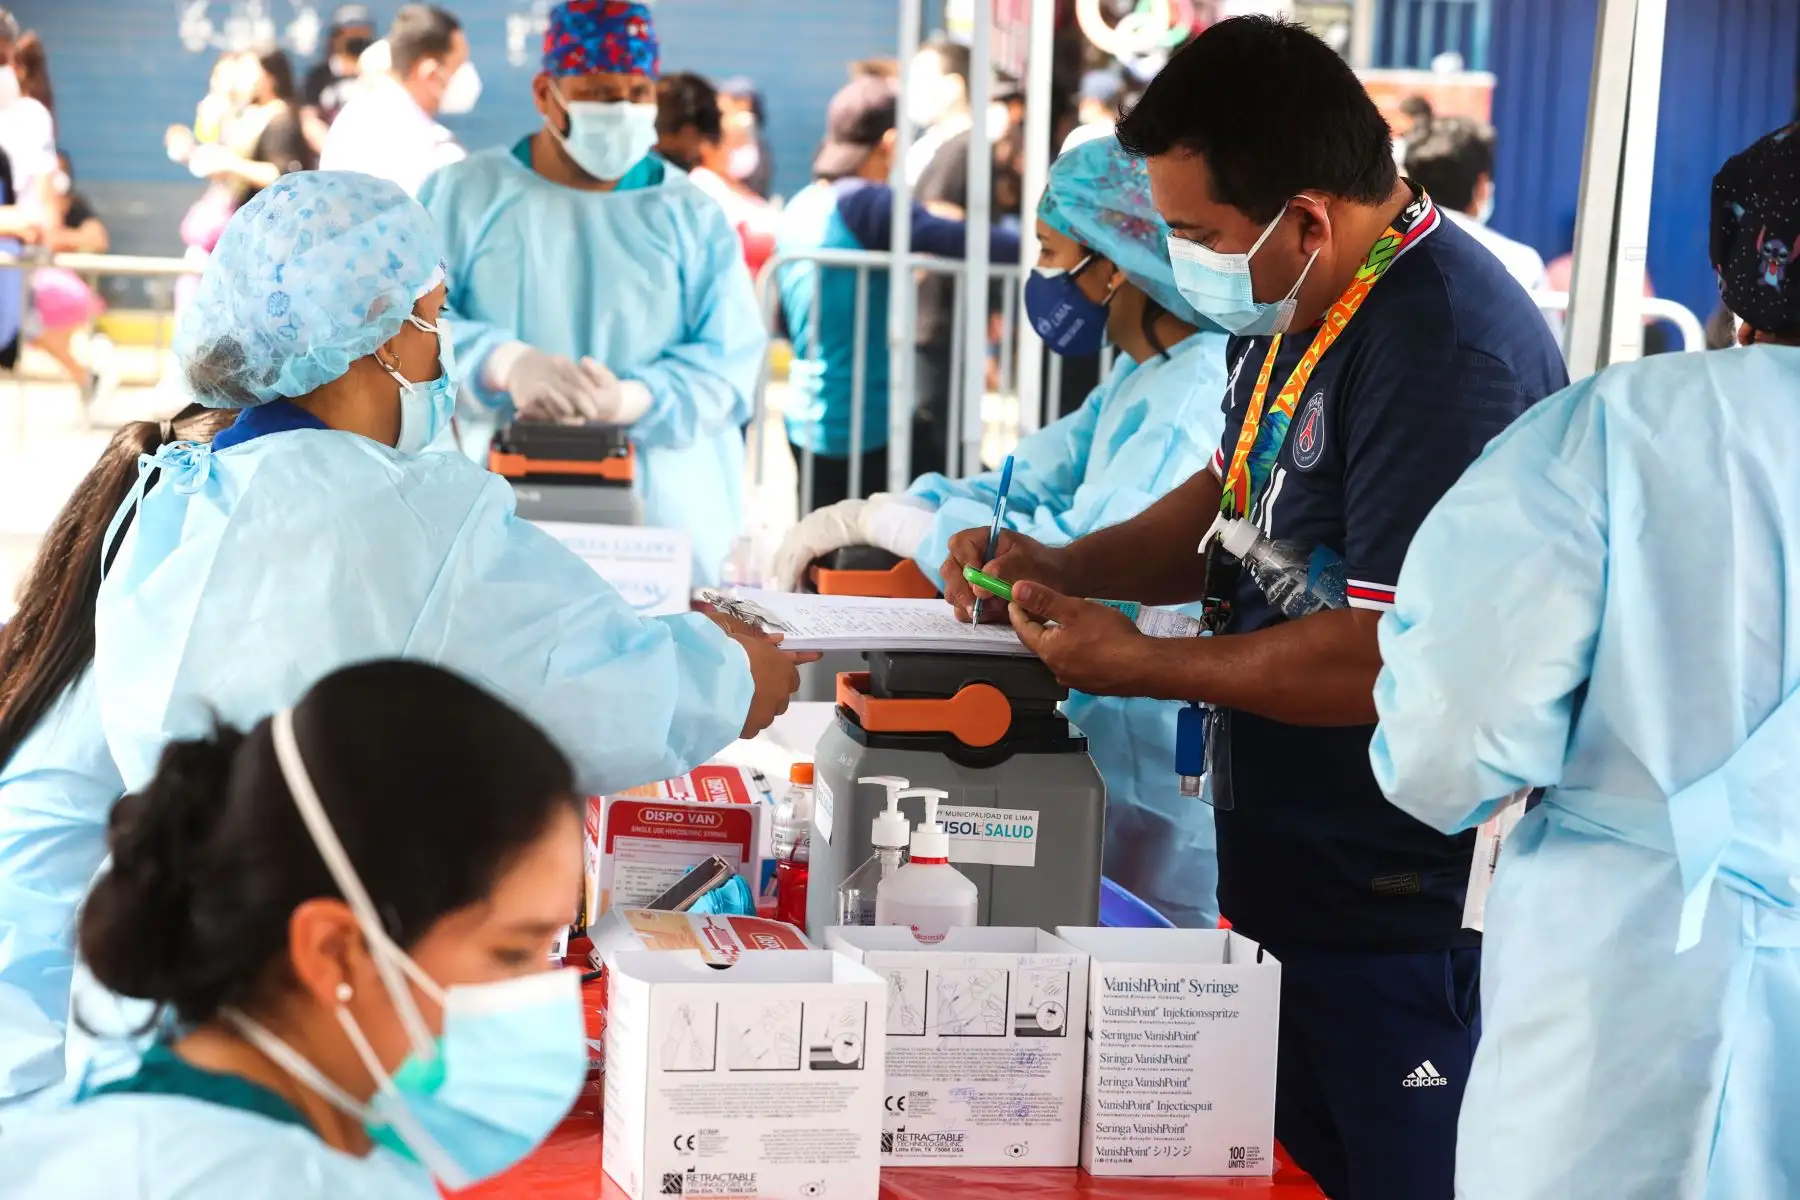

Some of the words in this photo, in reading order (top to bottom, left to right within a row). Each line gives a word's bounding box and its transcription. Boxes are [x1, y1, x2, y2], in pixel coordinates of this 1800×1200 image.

[1277, 280, 1371, 420] SUZUKI
[645, 811, 684, 823] DISPO
[688, 813, 715, 825] VAN
[945, 811, 1002, 820] MUNICIPALIDAD
[935, 820, 980, 836] ISOL
[984, 823, 1034, 839] SALUD
[1188, 978, 1240, 997] Syringe
[1162, 1007, 1240, 1021] Injektionsspritze
[1100, 1029, 1143, 1042] Seringue
[1099, 1052, 1133, 1066] Siringa
[1097, 1076, 1134, 1089] Jeringa
[1402, 1075, 1448, 1088] adidas
[1157, 1100, 1213, 1114] Injectiespuit
[1095, 1122, 1131, 1136] Seringa
[896, 1133, 964, 1142] RETRACTABLE
[1153, 1145, 1192, 1158] シリンジ
[1229, 1146, 1245, 1160] 100
[1228, 1159, 1245, 1169] UNITS
[686, 1172, 758, 1182] RETRACTABLE
